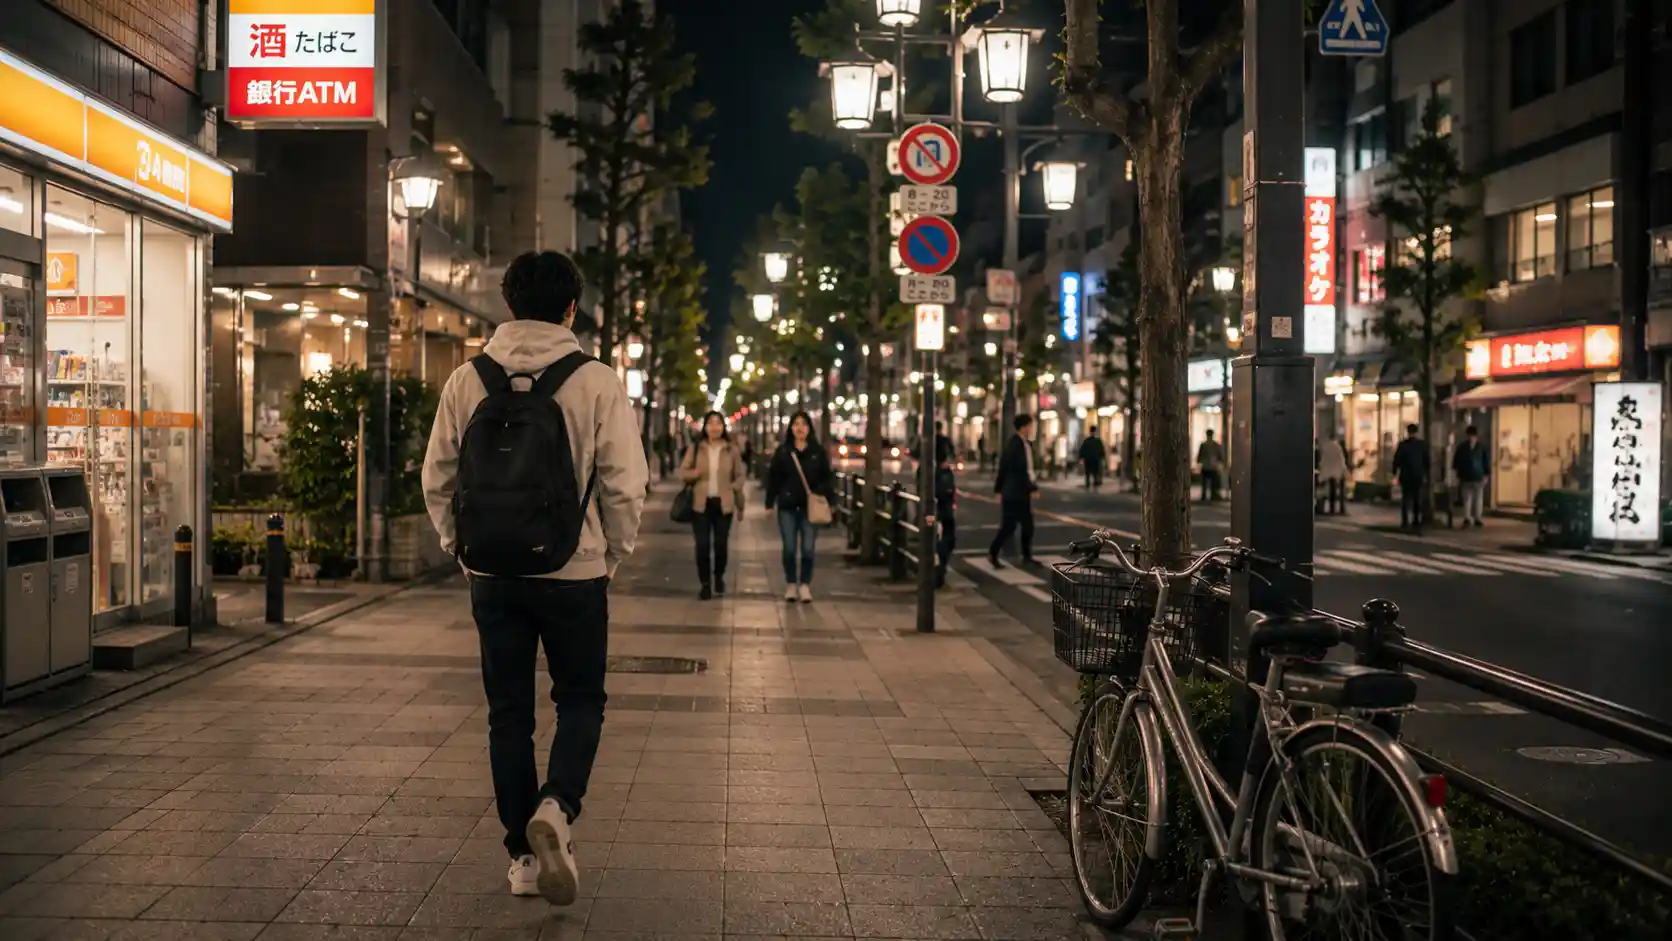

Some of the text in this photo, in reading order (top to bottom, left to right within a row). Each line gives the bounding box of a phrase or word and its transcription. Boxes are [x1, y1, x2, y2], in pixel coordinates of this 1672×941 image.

[249, 23, 357, 58] 酒 たばこ
[247, 80, 356, 105] 銀行ATM
[1308, 199, 1331, 302] カラオケ
